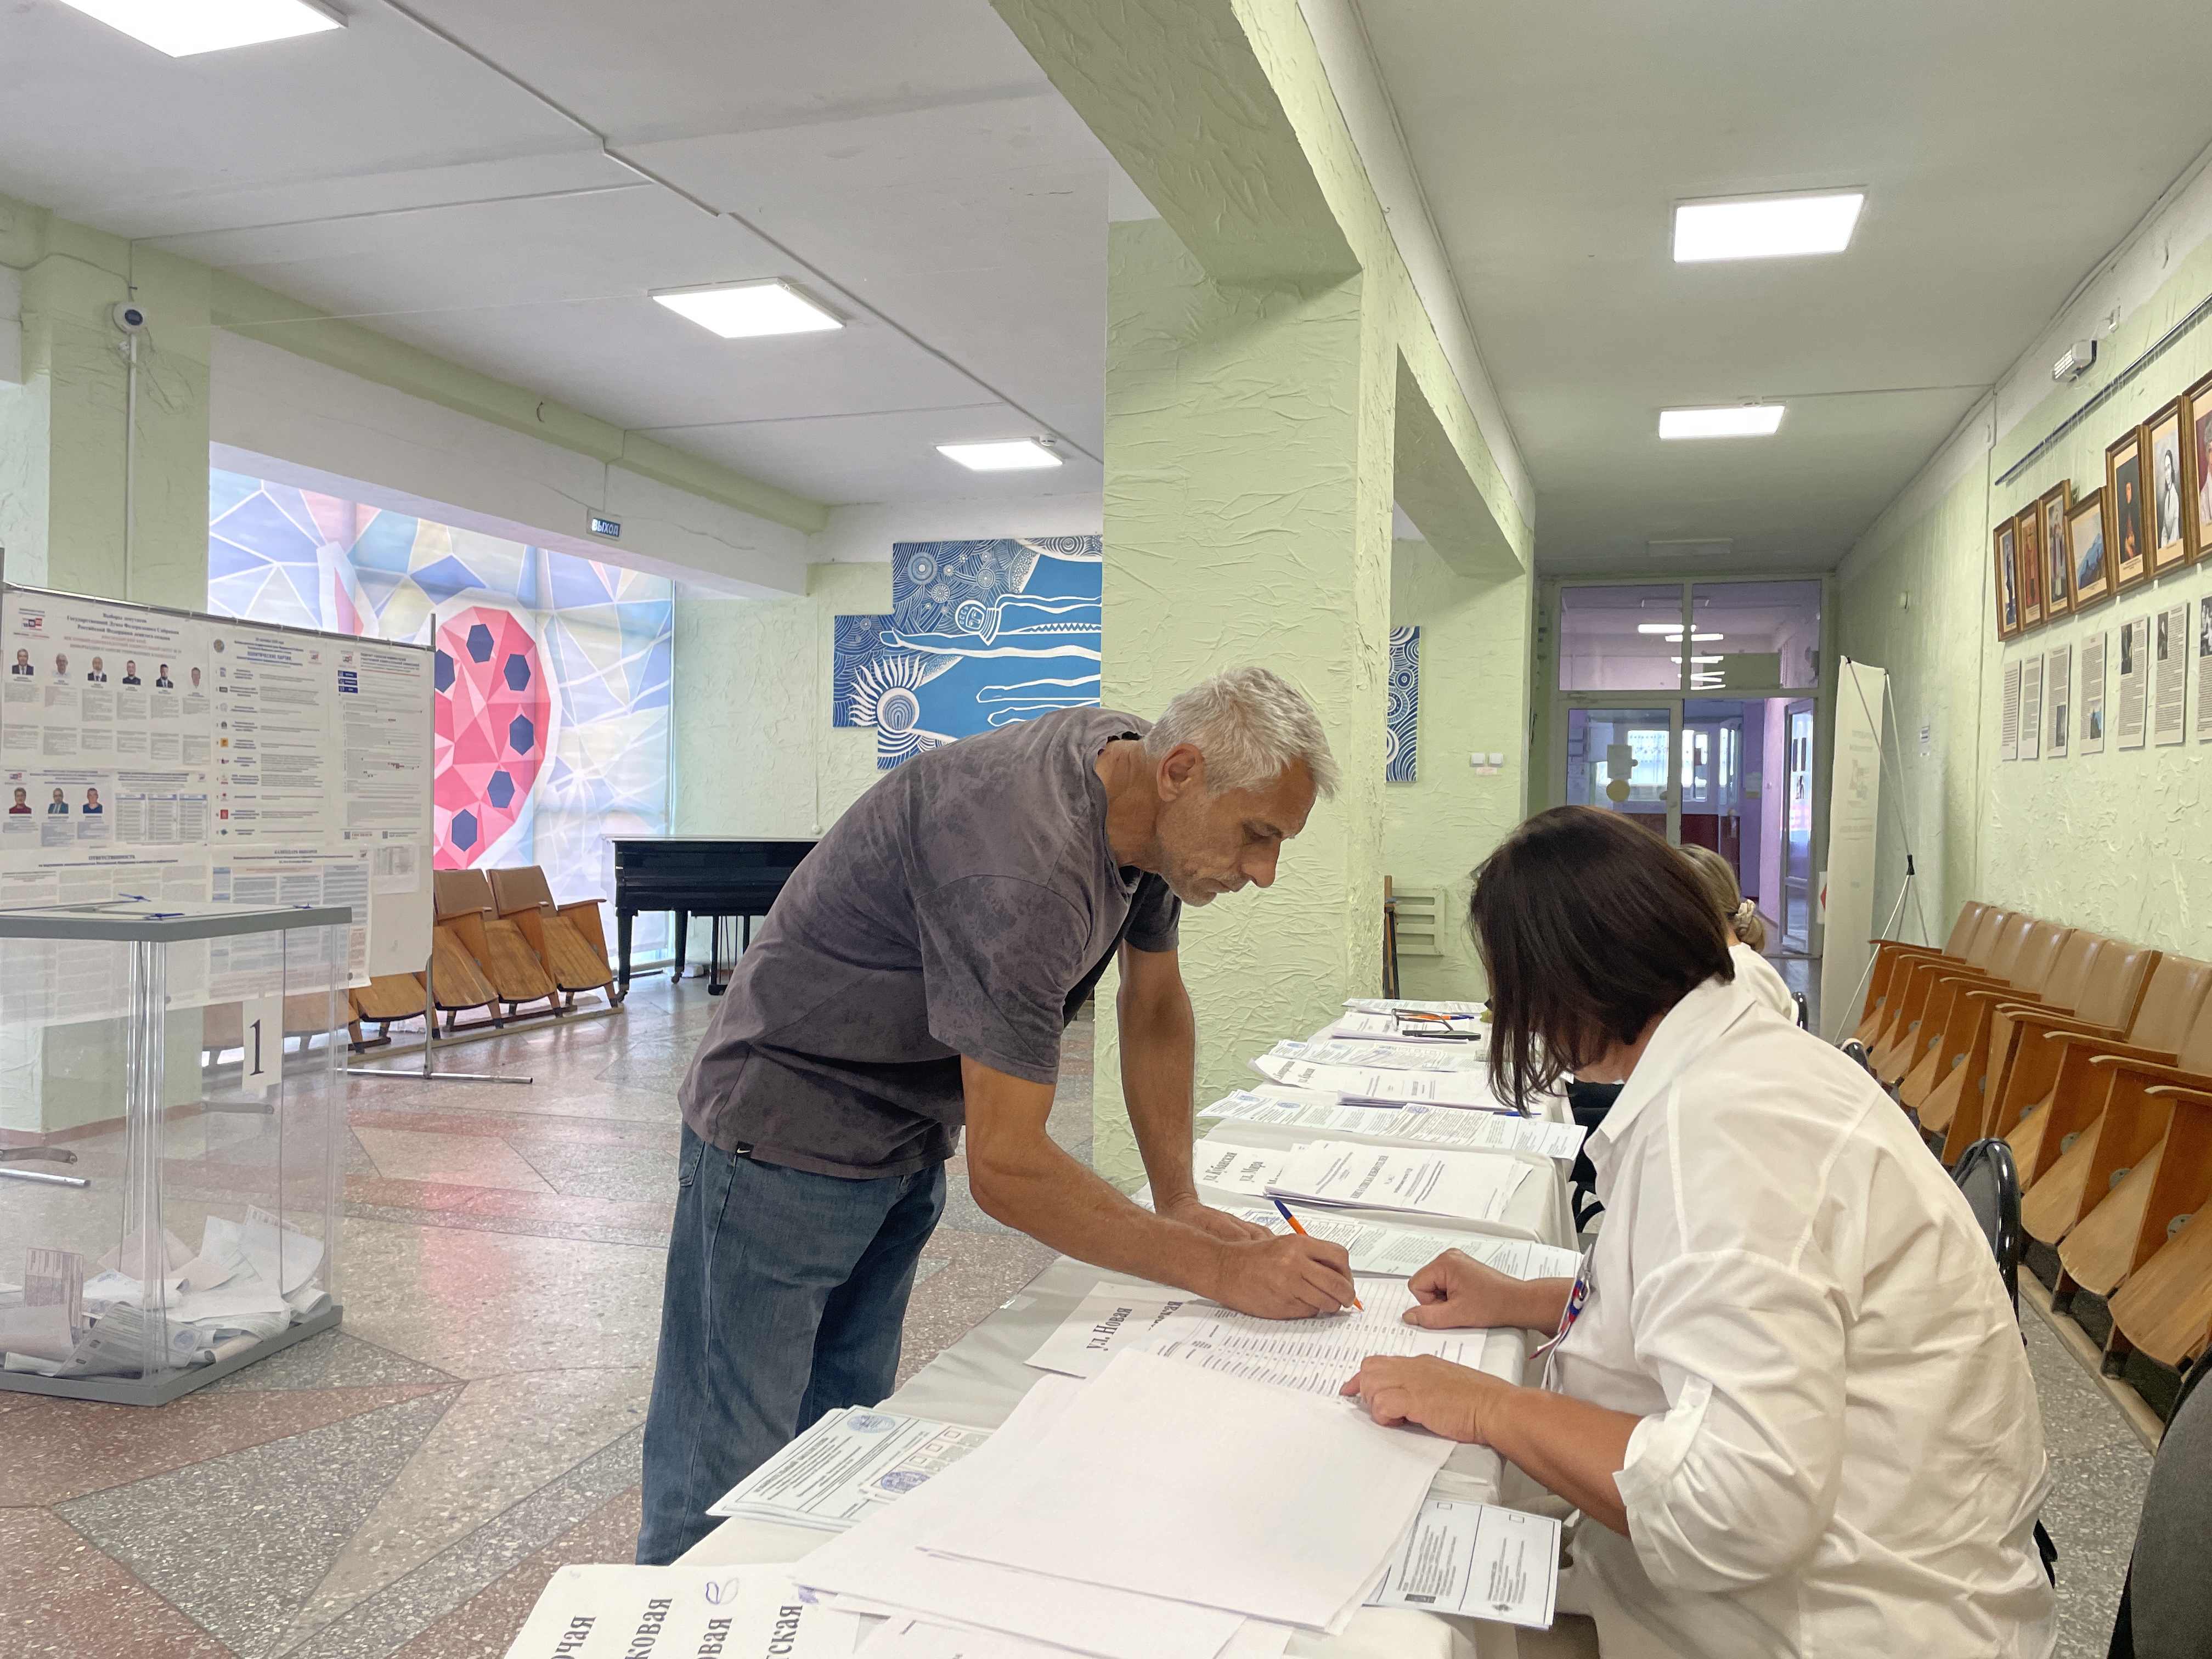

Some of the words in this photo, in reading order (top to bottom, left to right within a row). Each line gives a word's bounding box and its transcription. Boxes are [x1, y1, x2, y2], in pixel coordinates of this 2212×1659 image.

[591, 518, 619, 536] ВЫХОД
[250, 1019, 264, 1076] 1
[1240, 1161, 1266, 1175] Мира
[1092, 1307, 1133, 1335] Новая
[1086, 1337, 1110, 1351] ул.
[697, 1618, 733, 1659] вая
